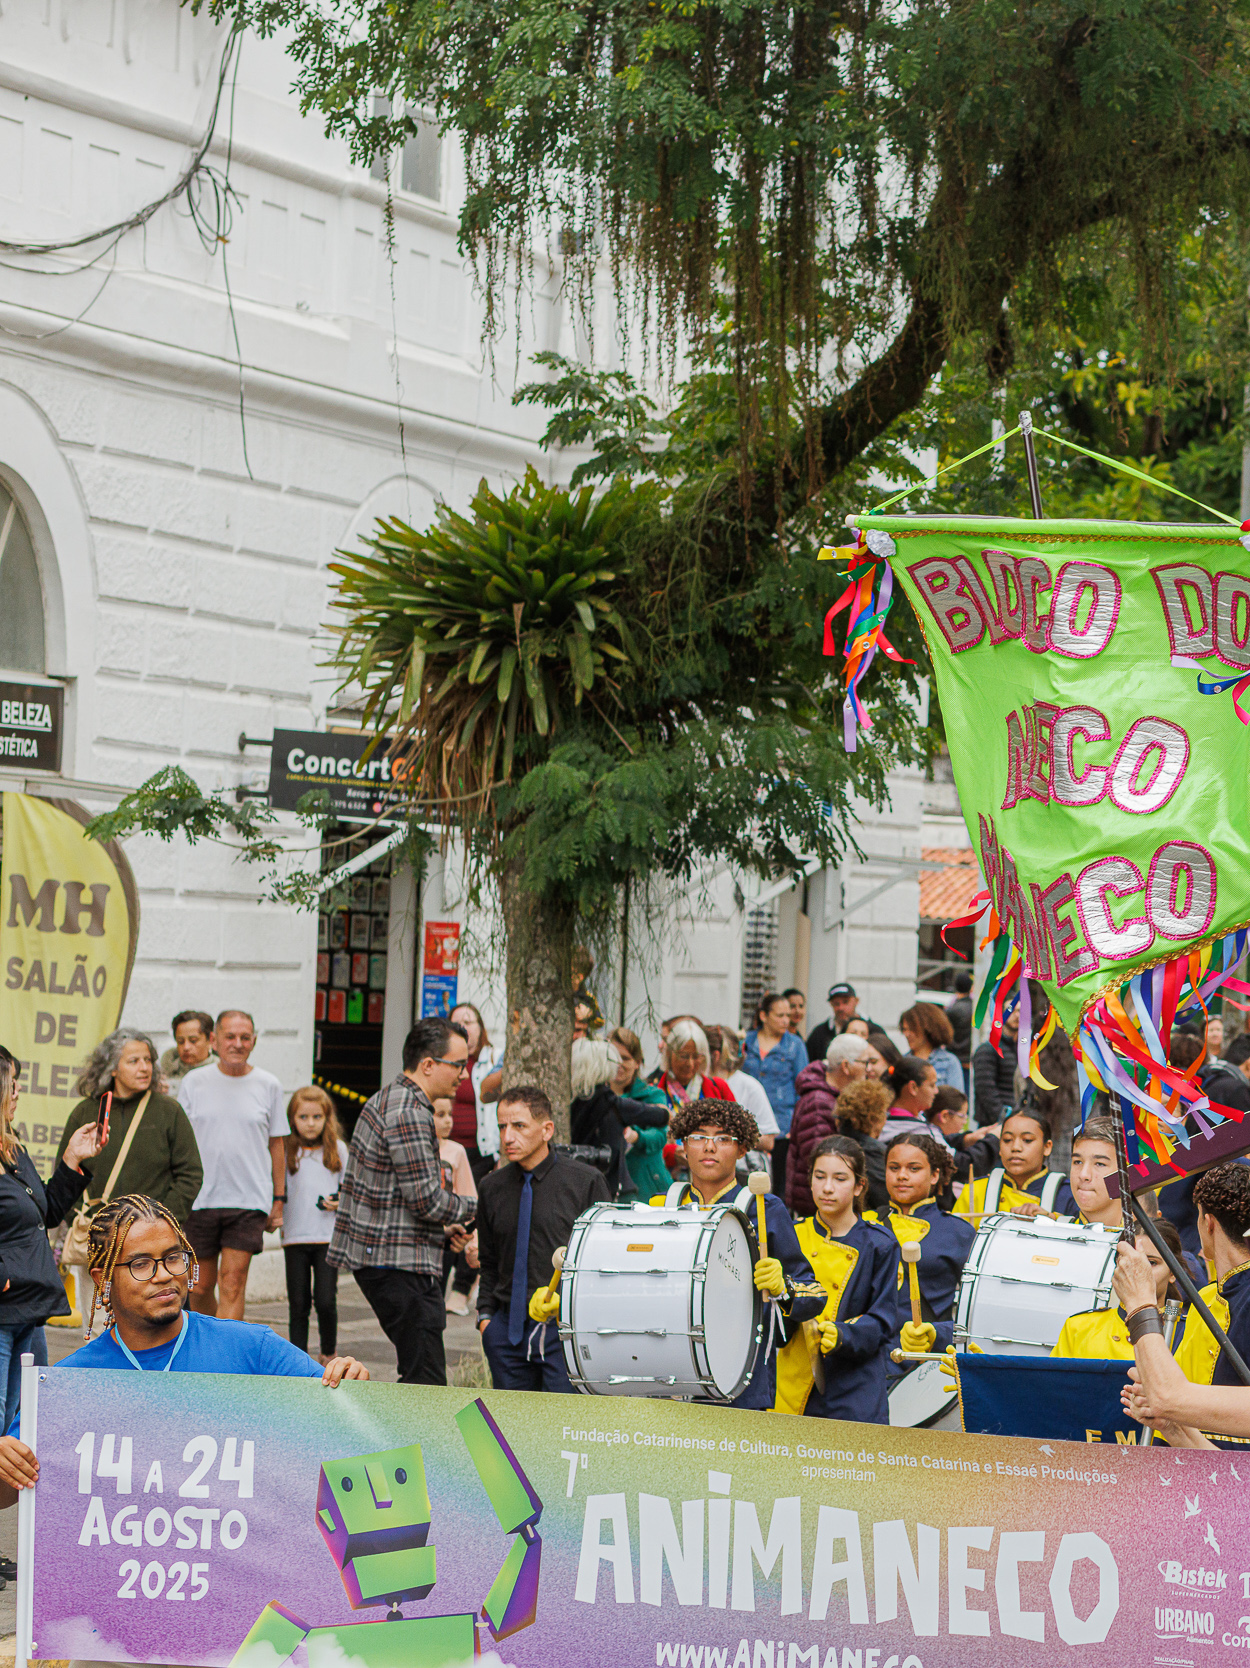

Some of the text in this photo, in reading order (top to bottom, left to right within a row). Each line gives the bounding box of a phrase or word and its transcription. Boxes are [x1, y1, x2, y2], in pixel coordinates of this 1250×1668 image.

[1, 700, 52, 728] BELEZA
[0, 733, 38, 758] STÉTICA
[6, 873, 111, 937] MH
[5, 954, 107, 998] SALÃO
[34, 1011, 78, 1047] DE
[16, 1061, 88, 1098] ELEZ
[74, 1431, 255, 1499] 14 A 24
[562, 1426, 1119, 1486] Fundação Catarinense de Cultura, Governo de Santa Catarina e Essaé Produções
[801, 1464, 877, 1483] apresentam
[77, 1495, 249, 1550] AGOSTO
[116, 1559, 210, 1601] 2025
[1154, 1606, 1215, 1636] URBANO
